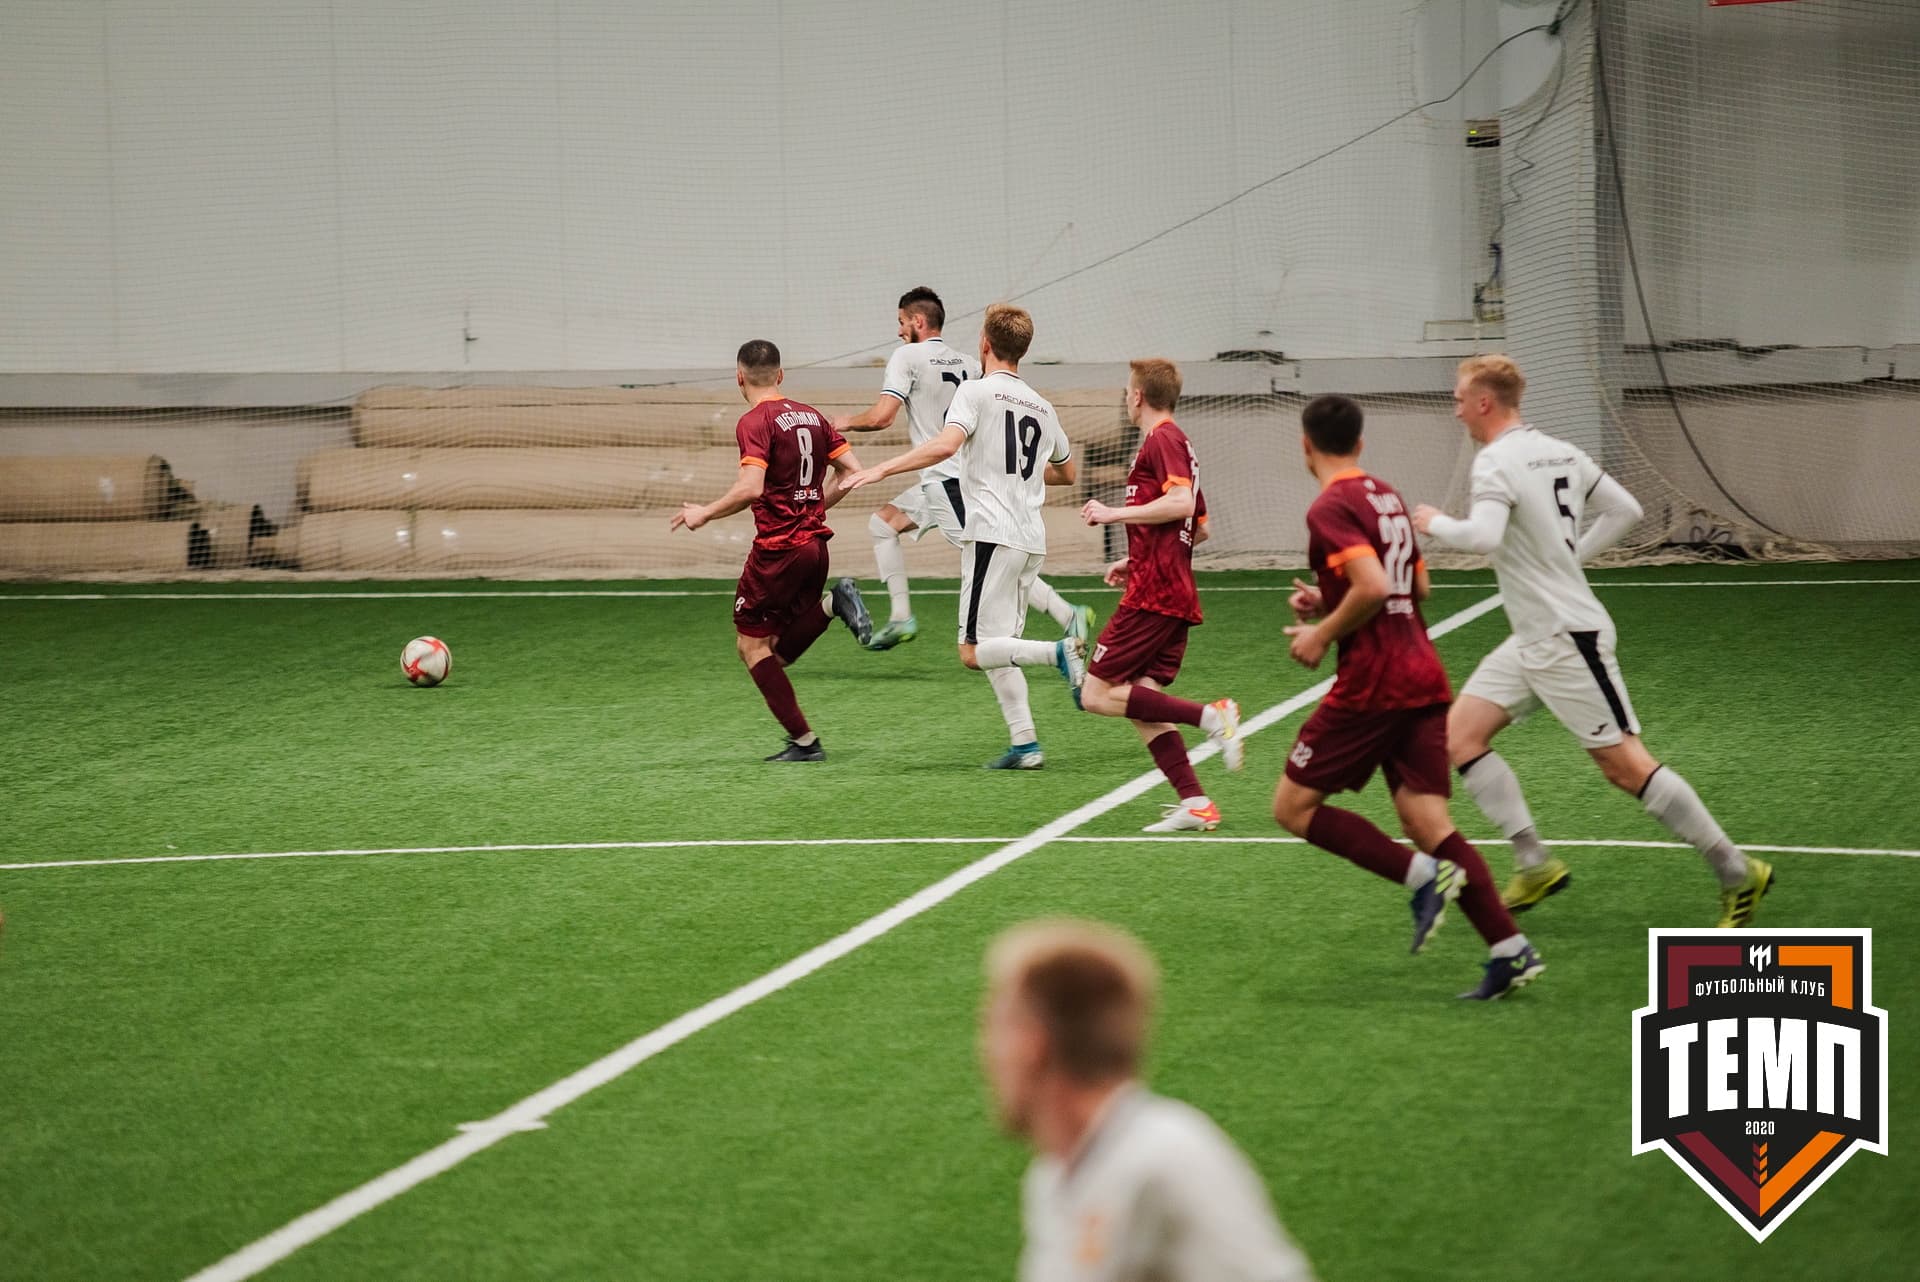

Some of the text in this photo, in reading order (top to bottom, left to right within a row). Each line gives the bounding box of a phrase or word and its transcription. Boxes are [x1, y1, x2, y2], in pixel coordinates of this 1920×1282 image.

[796, 428, 814, 486] 8
[1005, 410, 1042, 481] 19
[1554, 477, 1576, 554] 5
[1378, 515, 1413, 594] 22
[1289, 741, 1313, 768] 22
